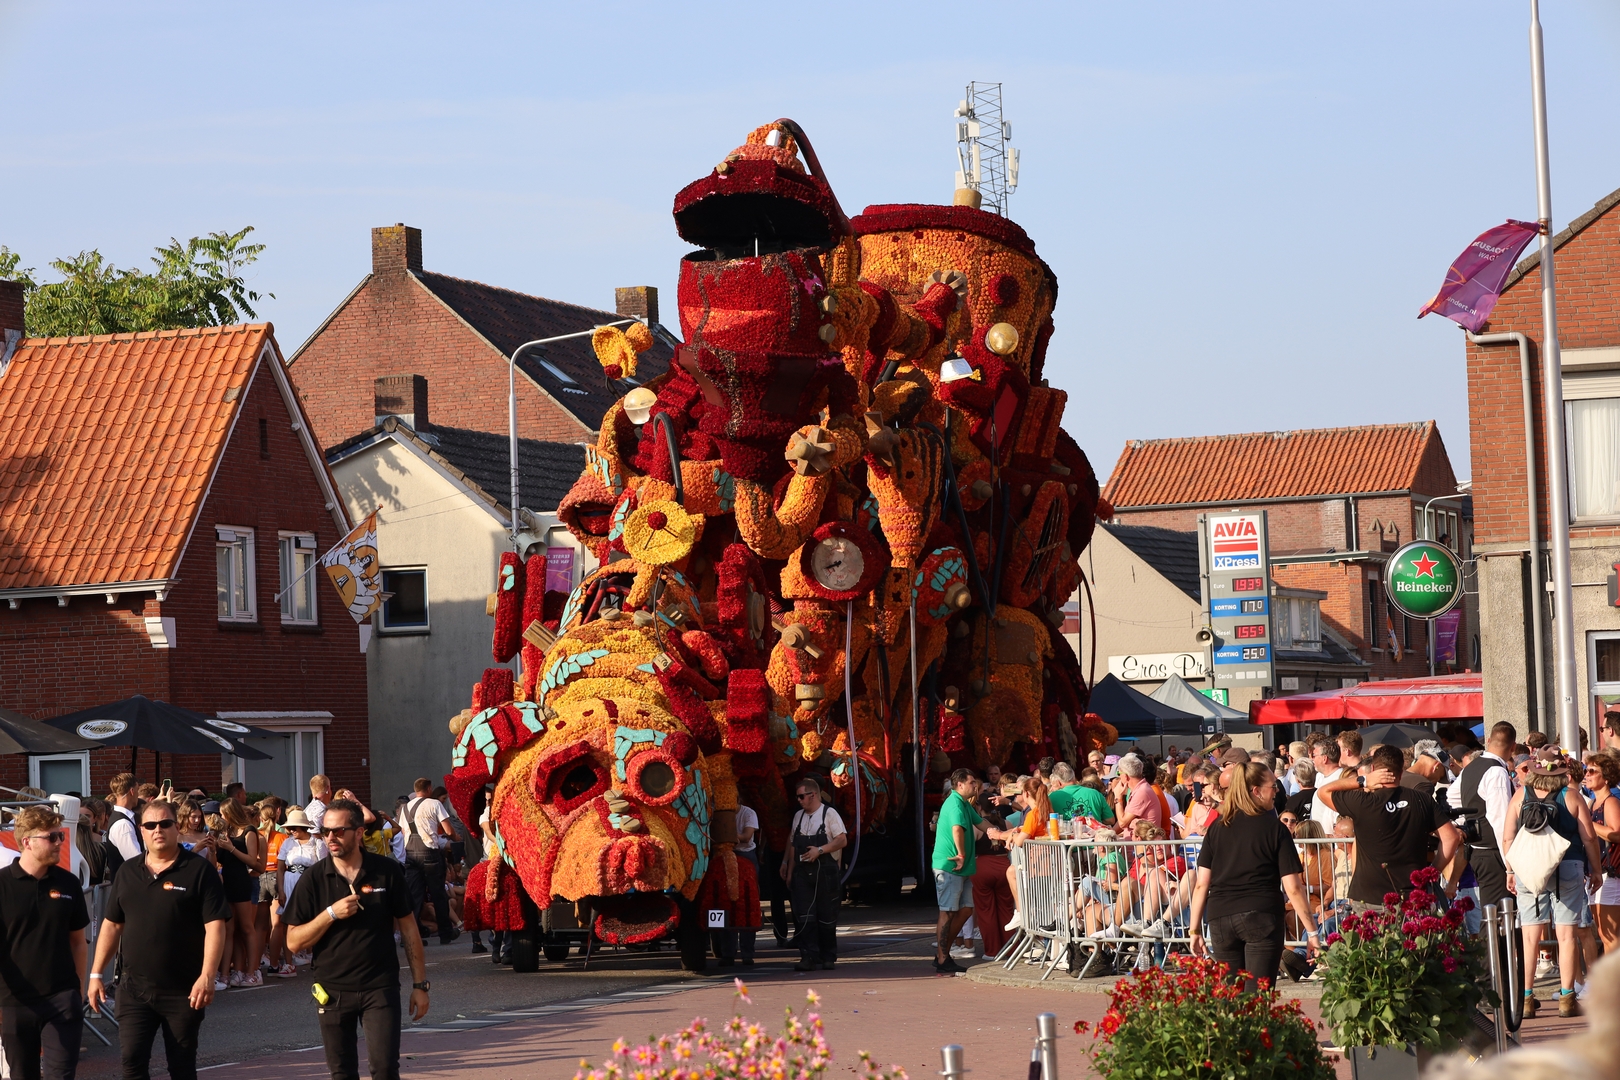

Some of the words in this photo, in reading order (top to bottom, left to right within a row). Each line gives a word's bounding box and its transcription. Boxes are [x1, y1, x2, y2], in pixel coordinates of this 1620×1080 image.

[1216, 556, 1257, 567] XPress
[1396, 581, 1453, 593] Heineken
[1121, 655, 1167, 680] Eros
[710, 912, 723, 922] 07
